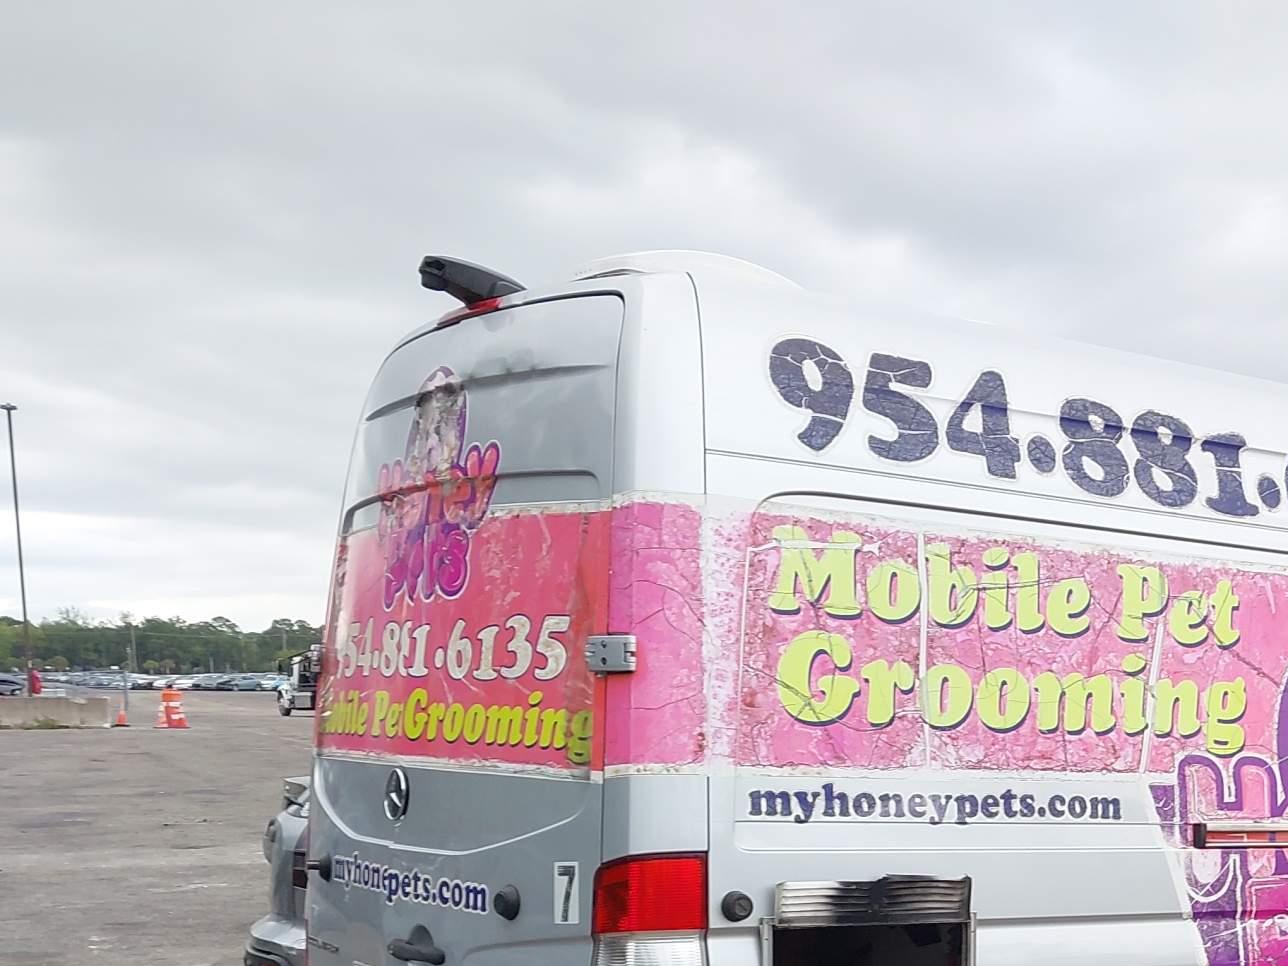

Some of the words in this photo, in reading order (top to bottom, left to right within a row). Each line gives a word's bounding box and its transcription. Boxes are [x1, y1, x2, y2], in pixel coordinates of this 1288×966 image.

[769, 525, 1091, 638] Mobile
[1116, 563, 1241, 649] Pet
[404, 687, 592, 763] Grooming
[777, 630, 1248, 758] Grooming
[748, 783, 1122, 826] myhoneypets.com
[556, 864, 577, 924] 7
